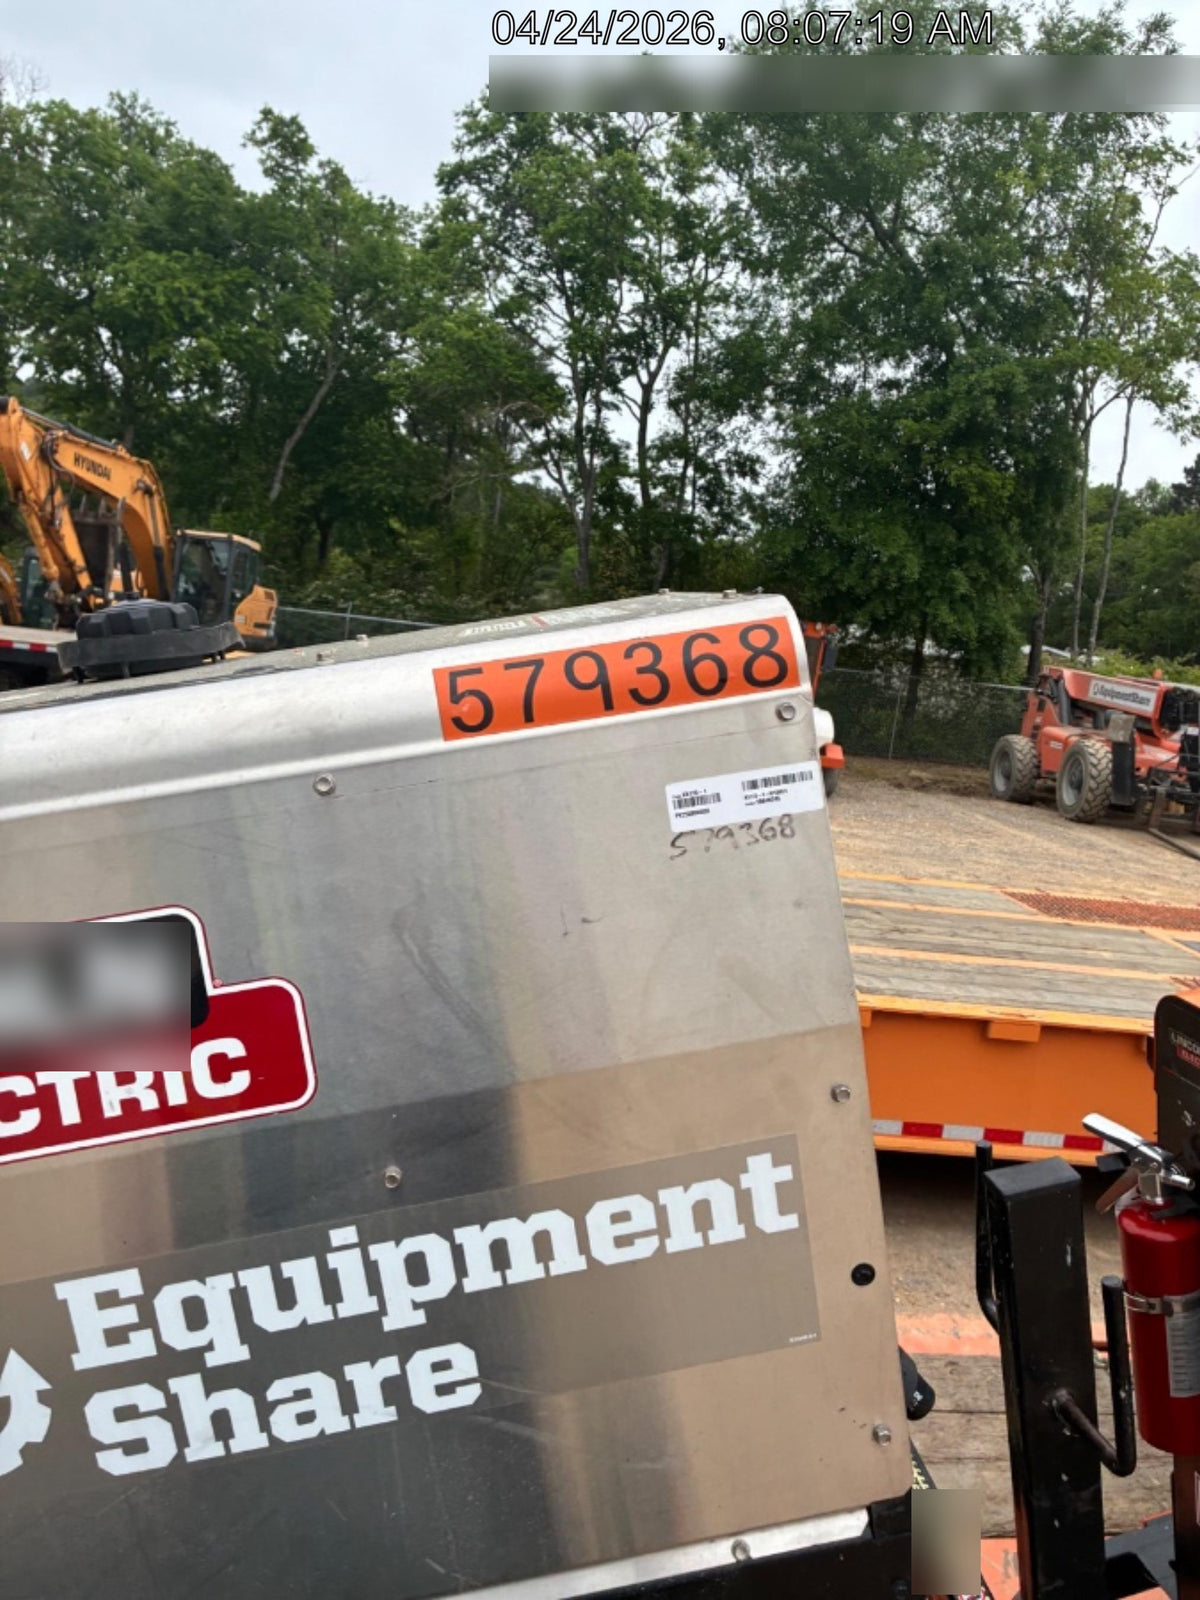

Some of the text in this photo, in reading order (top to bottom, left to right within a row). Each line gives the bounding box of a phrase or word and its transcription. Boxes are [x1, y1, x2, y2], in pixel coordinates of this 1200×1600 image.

[74, 452, 112, 481] HYUNDAI
[447, 622, 789, 734] 579368
[669, 813, 796, 861] 579368
[54, 1152, 800, 1370] Equipment
[84, 1342, 483, 1477] Share
